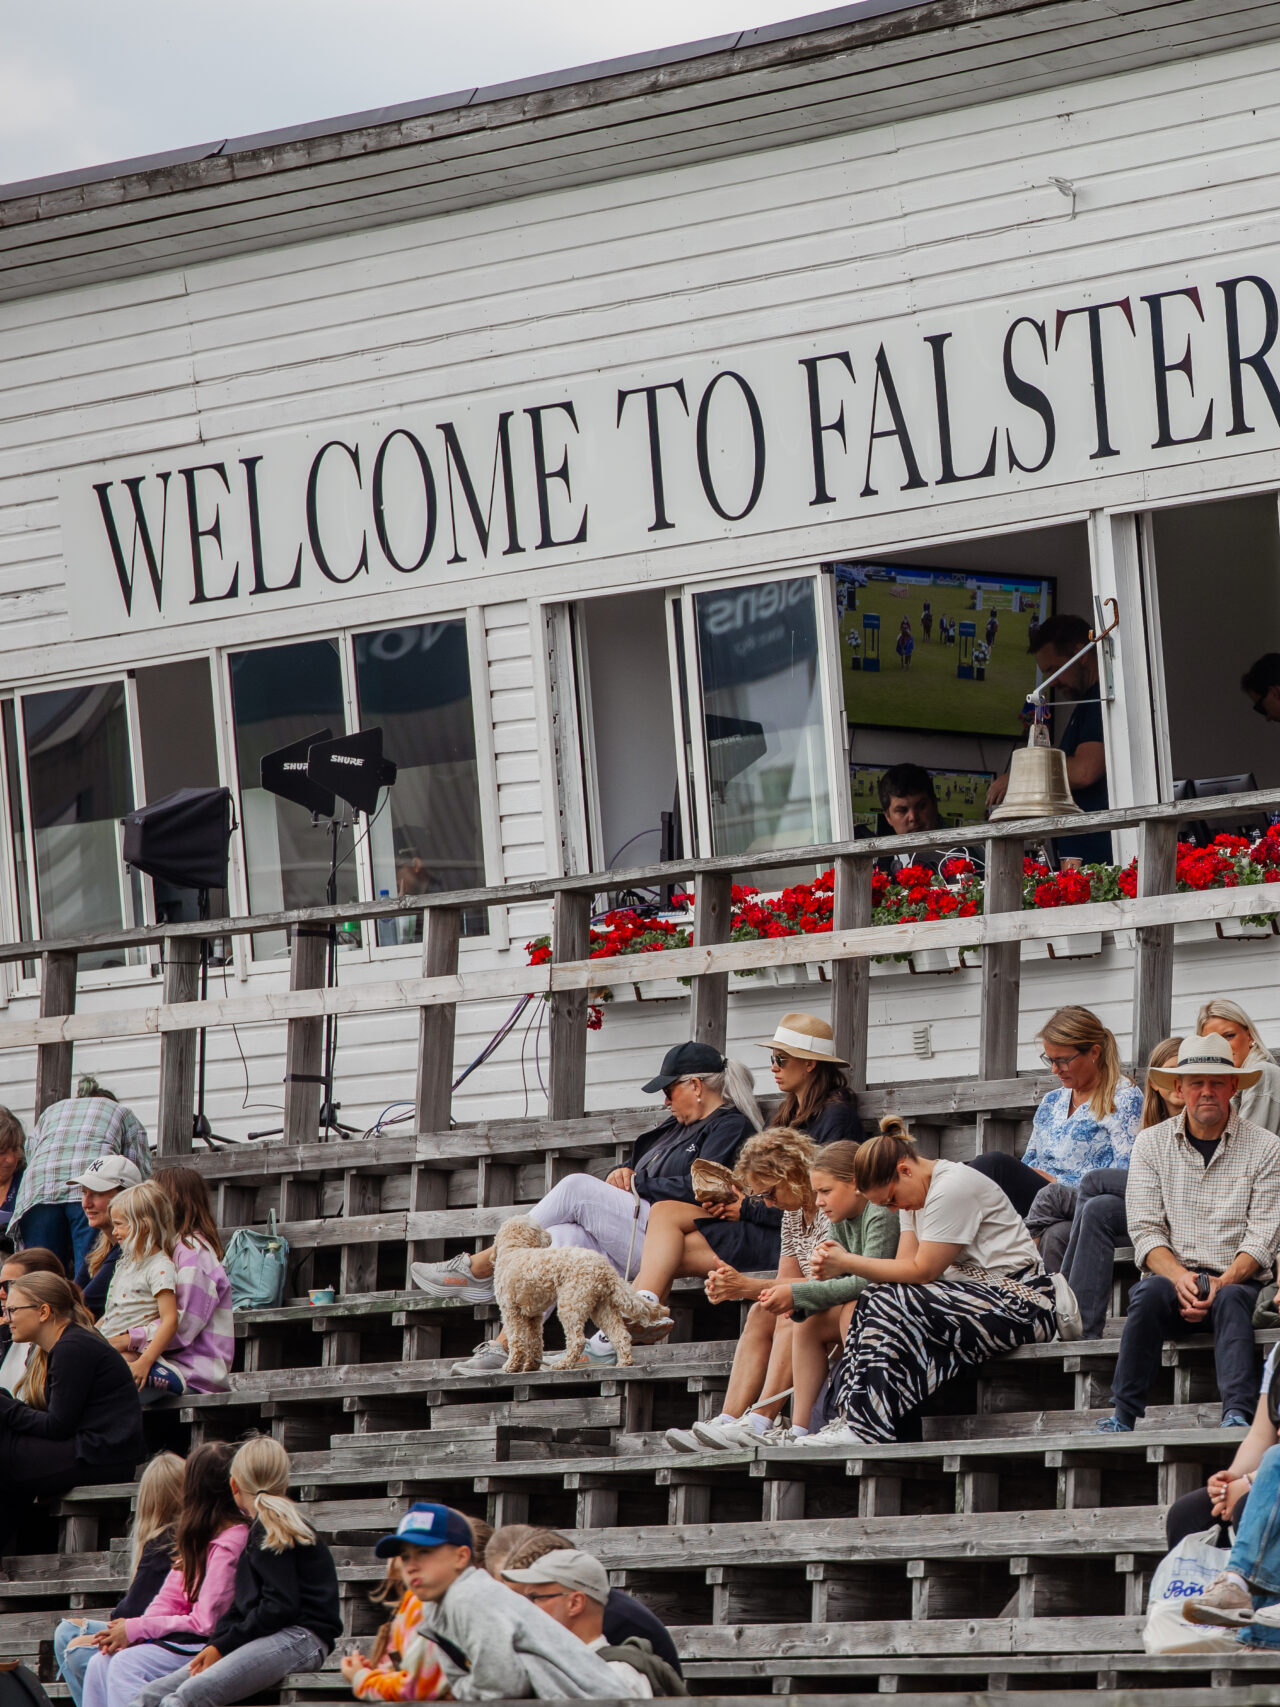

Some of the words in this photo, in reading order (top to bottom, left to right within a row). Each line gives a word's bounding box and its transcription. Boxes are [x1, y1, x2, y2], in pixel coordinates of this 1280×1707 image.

[93, 400, 588, 617] WELCOME
[616, 370, 766, 532] TO
[330, 754, 365, 767] SHURE
